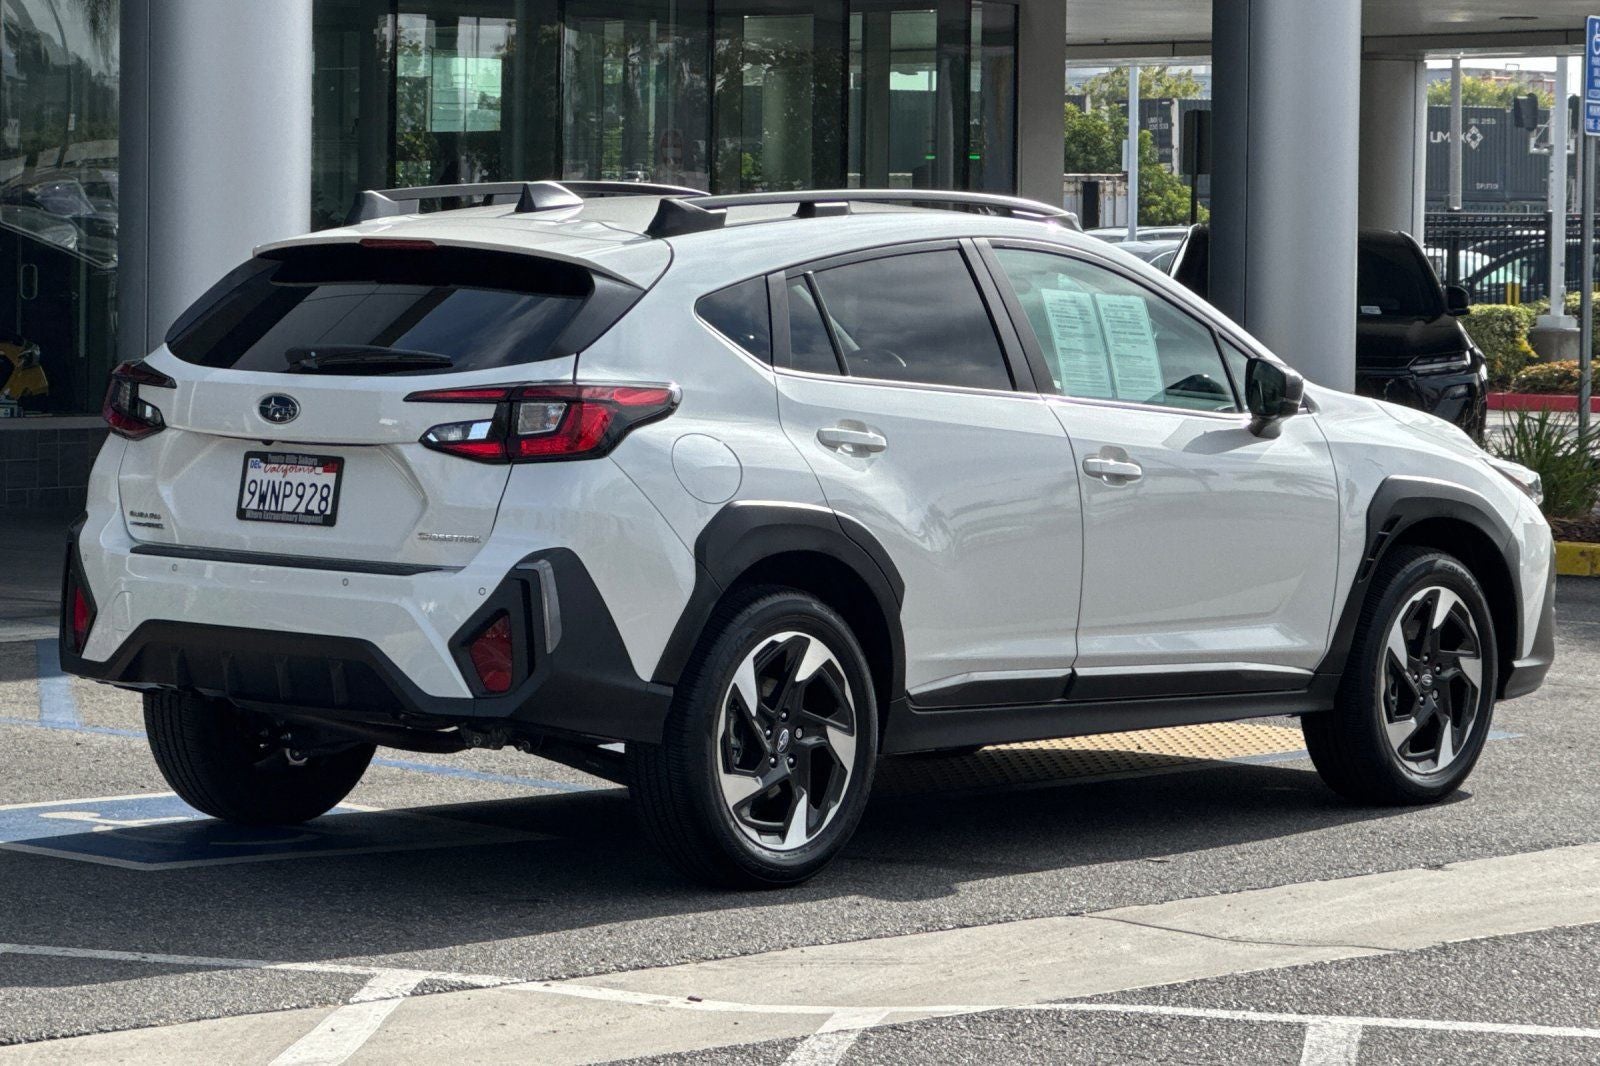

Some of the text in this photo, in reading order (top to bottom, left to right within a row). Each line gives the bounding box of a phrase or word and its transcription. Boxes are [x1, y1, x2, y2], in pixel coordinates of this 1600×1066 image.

[249, 460, 262, 469] DEC
[264, 463, 320, 478] California
[245, 479, 331, 515] 9WNP928
